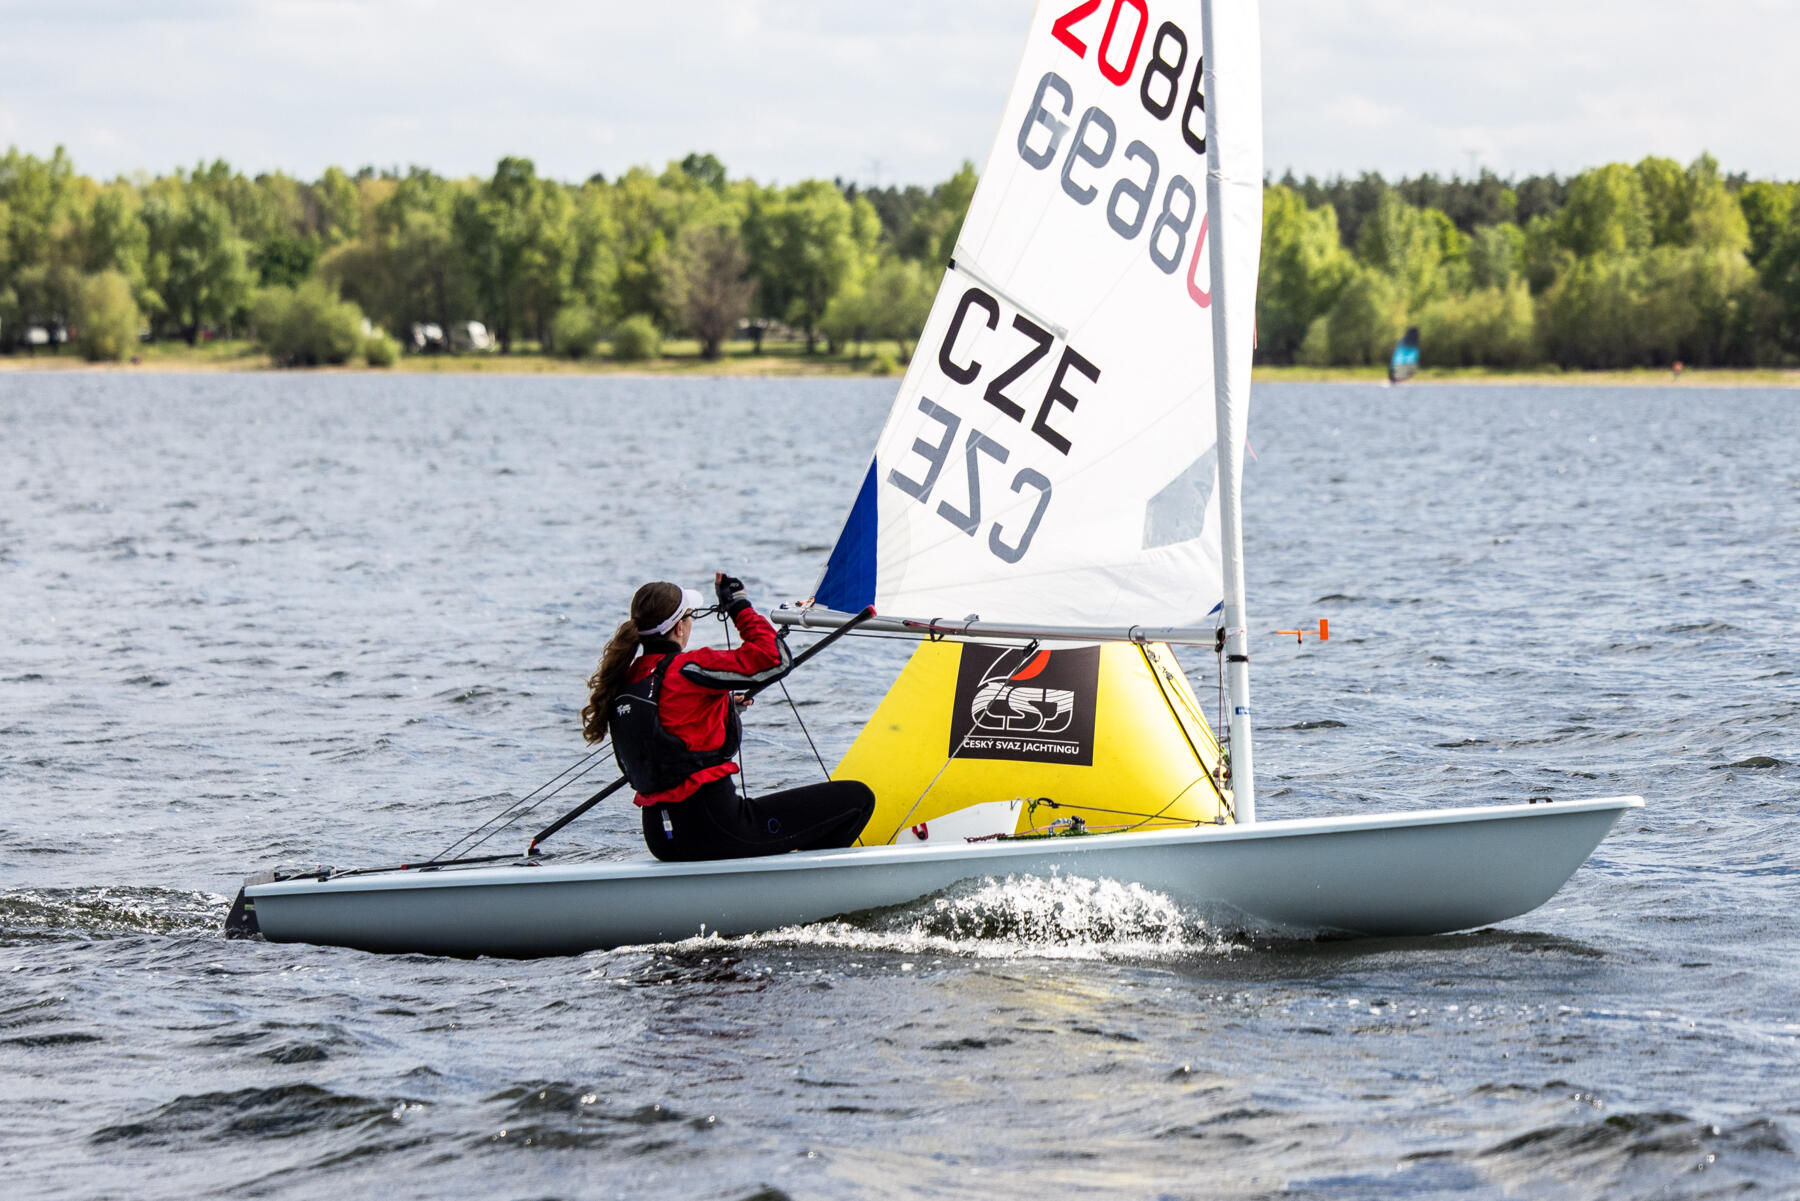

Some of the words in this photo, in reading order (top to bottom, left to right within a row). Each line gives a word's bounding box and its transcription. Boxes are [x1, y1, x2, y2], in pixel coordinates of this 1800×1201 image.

[939, 287, 1101, 456] CZE
[962, 738, 994, 749] ČESKÝ
[995, 740, 1021, 750] SVAZ
[1022, 742, 1080, 755] JACHTINGU
